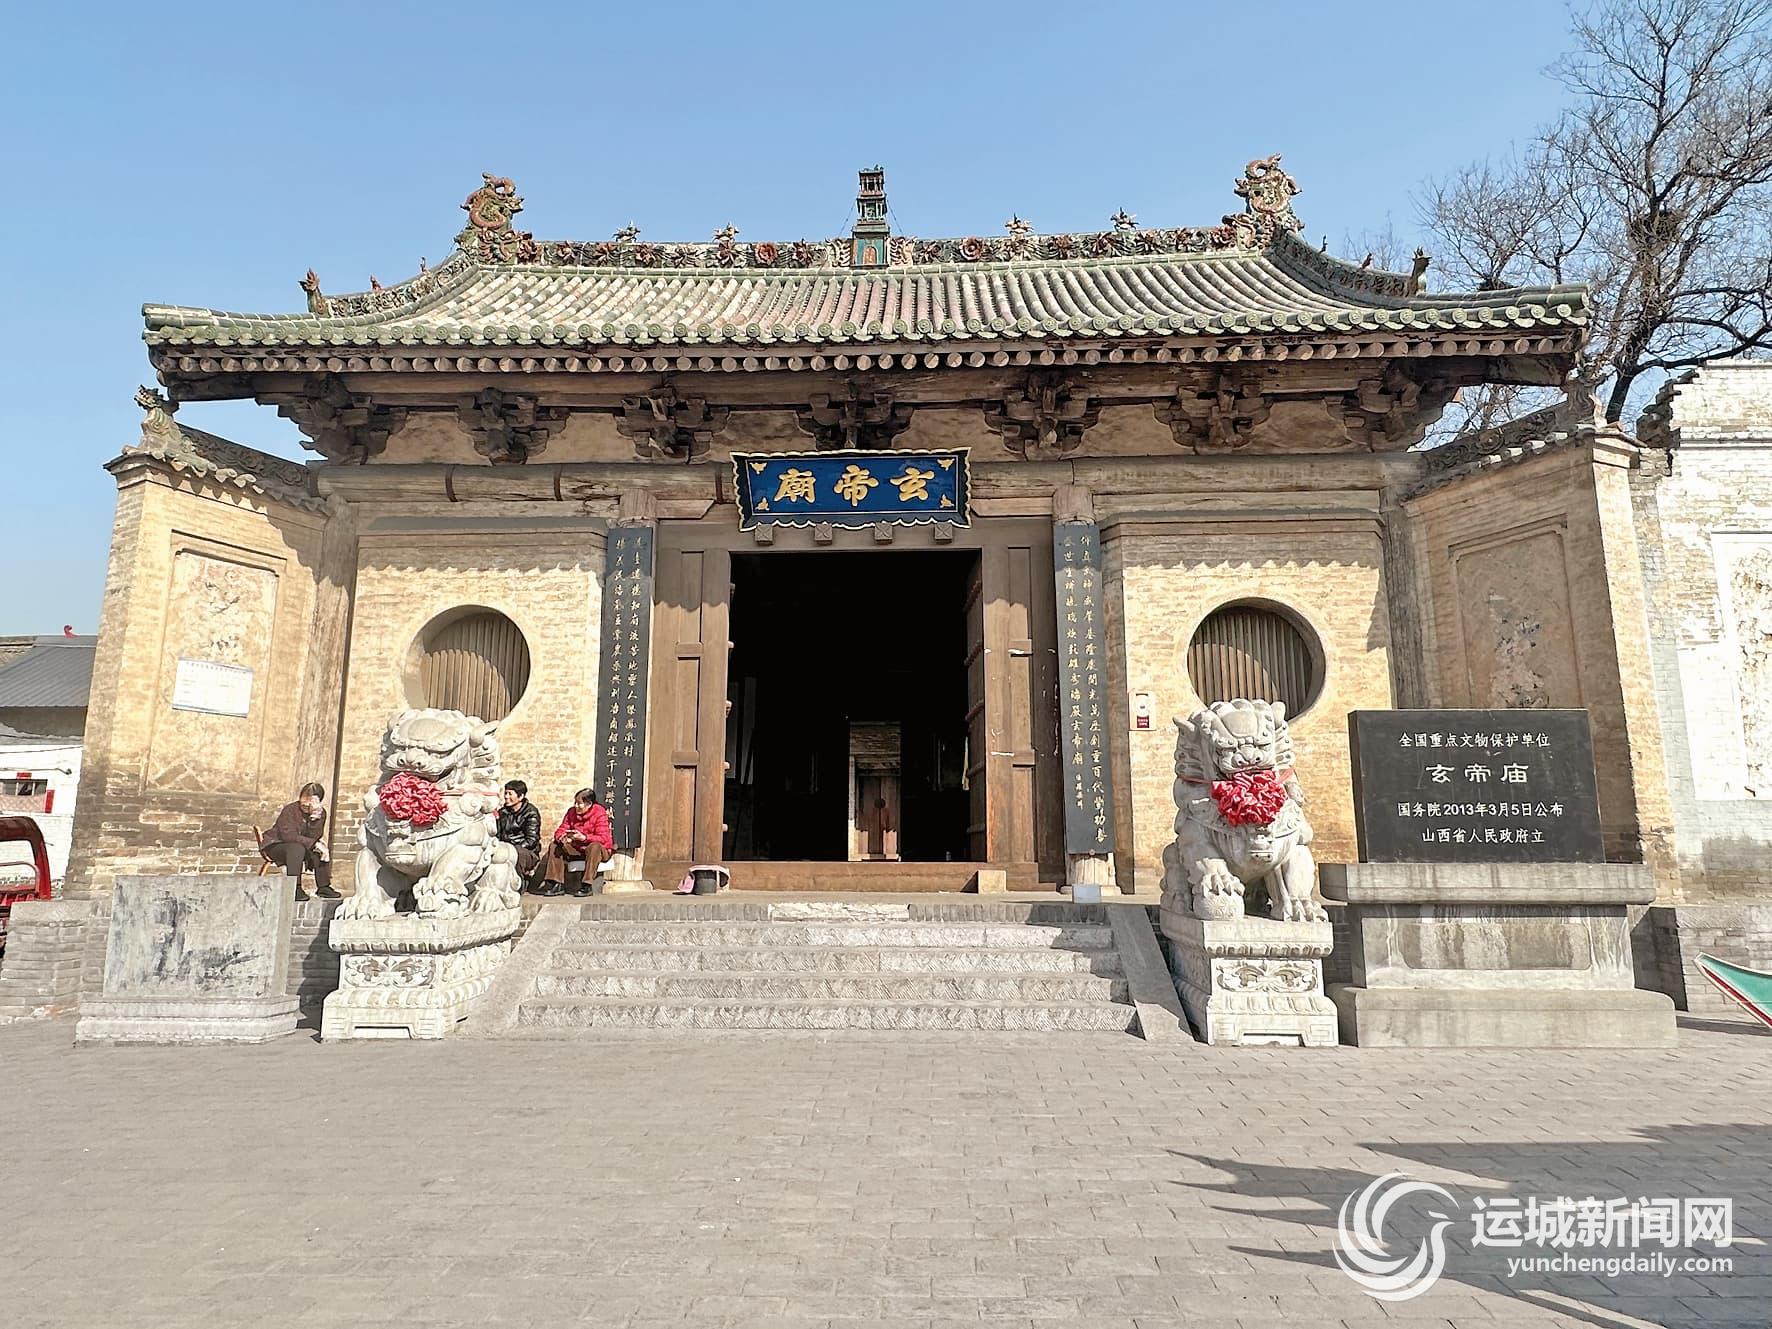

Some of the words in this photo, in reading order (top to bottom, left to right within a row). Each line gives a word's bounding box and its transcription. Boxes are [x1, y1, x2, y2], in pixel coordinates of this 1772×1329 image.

[1399, 733, 1551, 748] 全国重点文物保护单位
[1425, 763, 1529, 783] 玄帝庙
[1397, 802, 1564, 817] 国务院2013年3月5日公布
[1422, 828, 1545, 844] 山西省人民政府立
